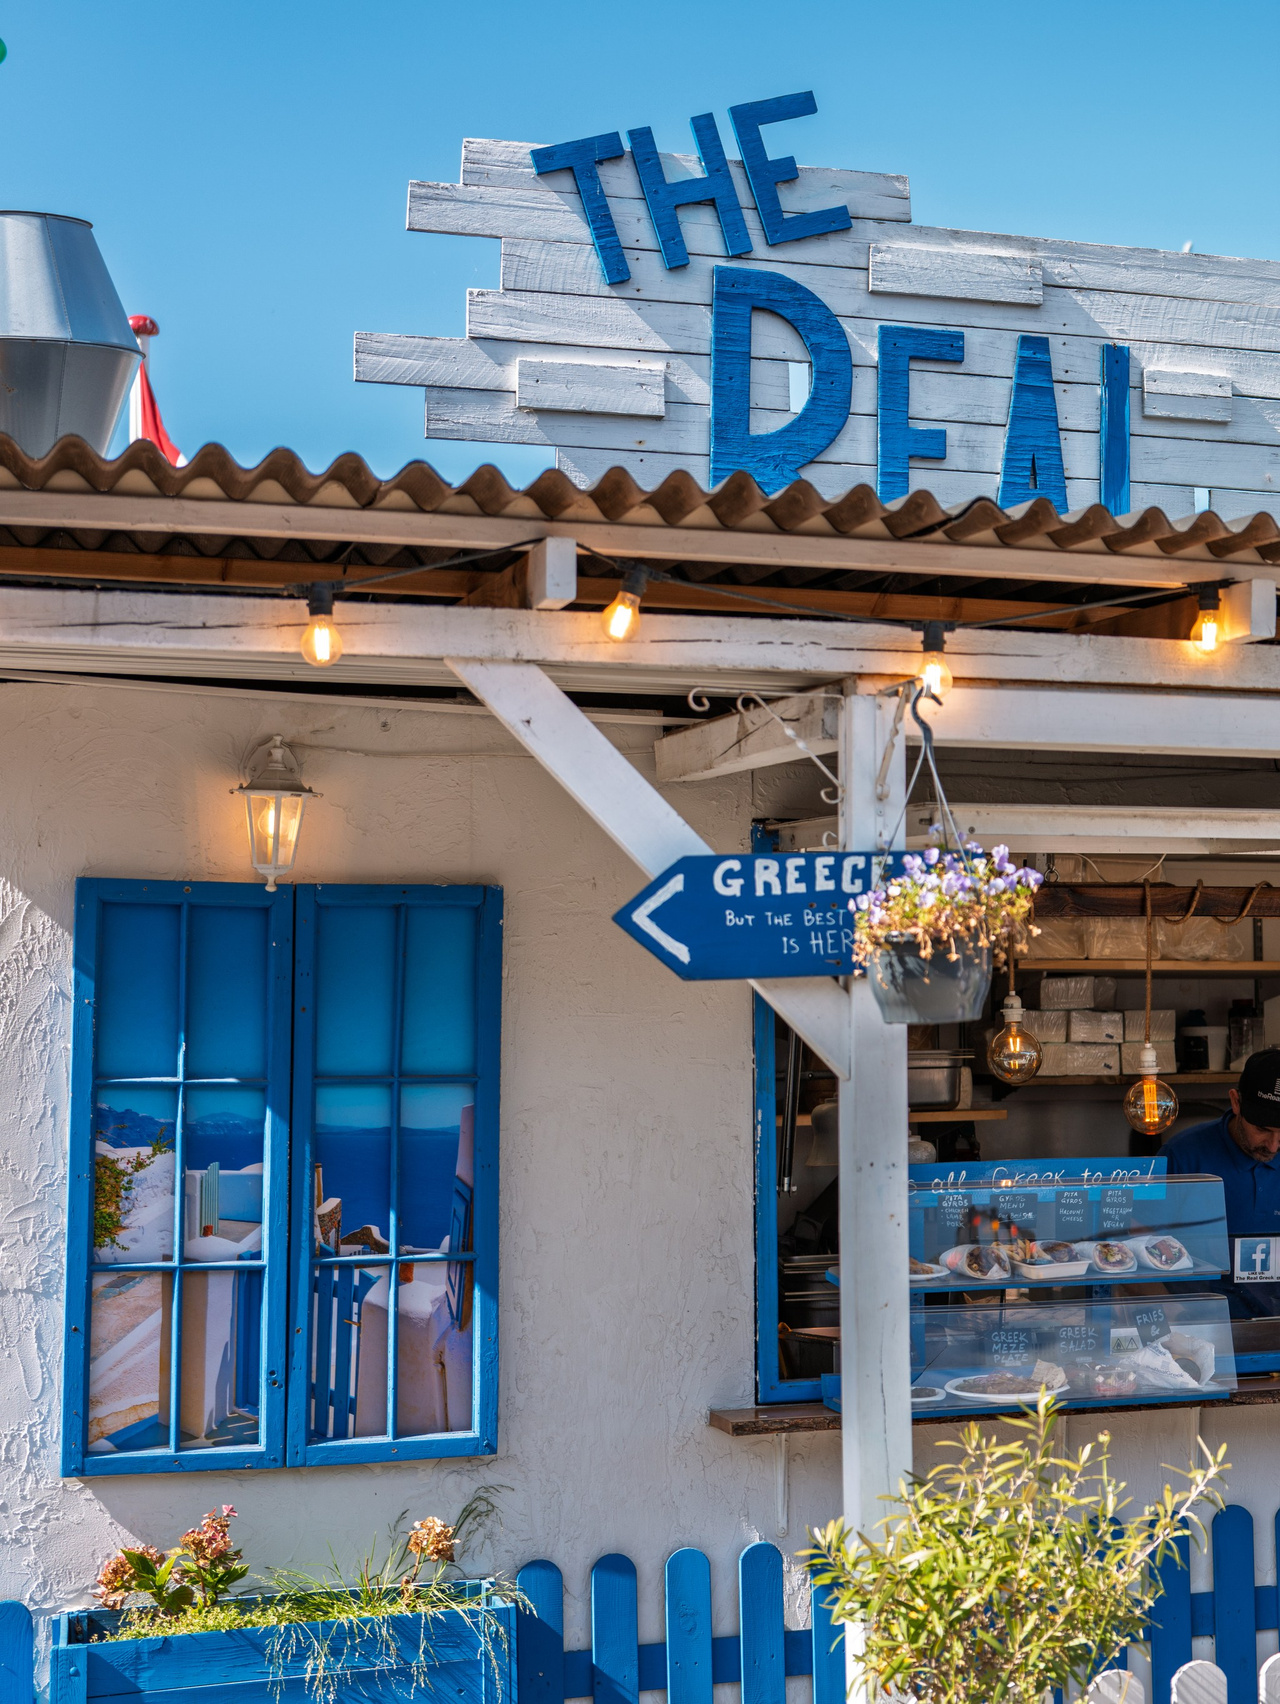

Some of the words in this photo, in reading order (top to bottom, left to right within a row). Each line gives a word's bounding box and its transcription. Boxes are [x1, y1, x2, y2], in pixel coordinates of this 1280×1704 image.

[530, 90, 852, 285] THE
[765, 911, 793, 926] THE
[804, 909, 847, 926] BEST
[782, 936, 800, 955] IS
[810, 928, 854, 955] HER
[931, 1170, 966, 1194] all
[1081, 1168, 1102, 1188] to
[1136, 1309, 1164, 1326] FRIES
[992, 1332, 1028, 1343] GREEK
[1059, 1327, 1098, 1339] GREEK
[1150, 1325, 1160, 1336] &
[992, 1344, 1025, 1353] MEZE
[1060, 1339, 1096, 1353] SALAD
[994, 1354, 1028, 1363] PLATE
